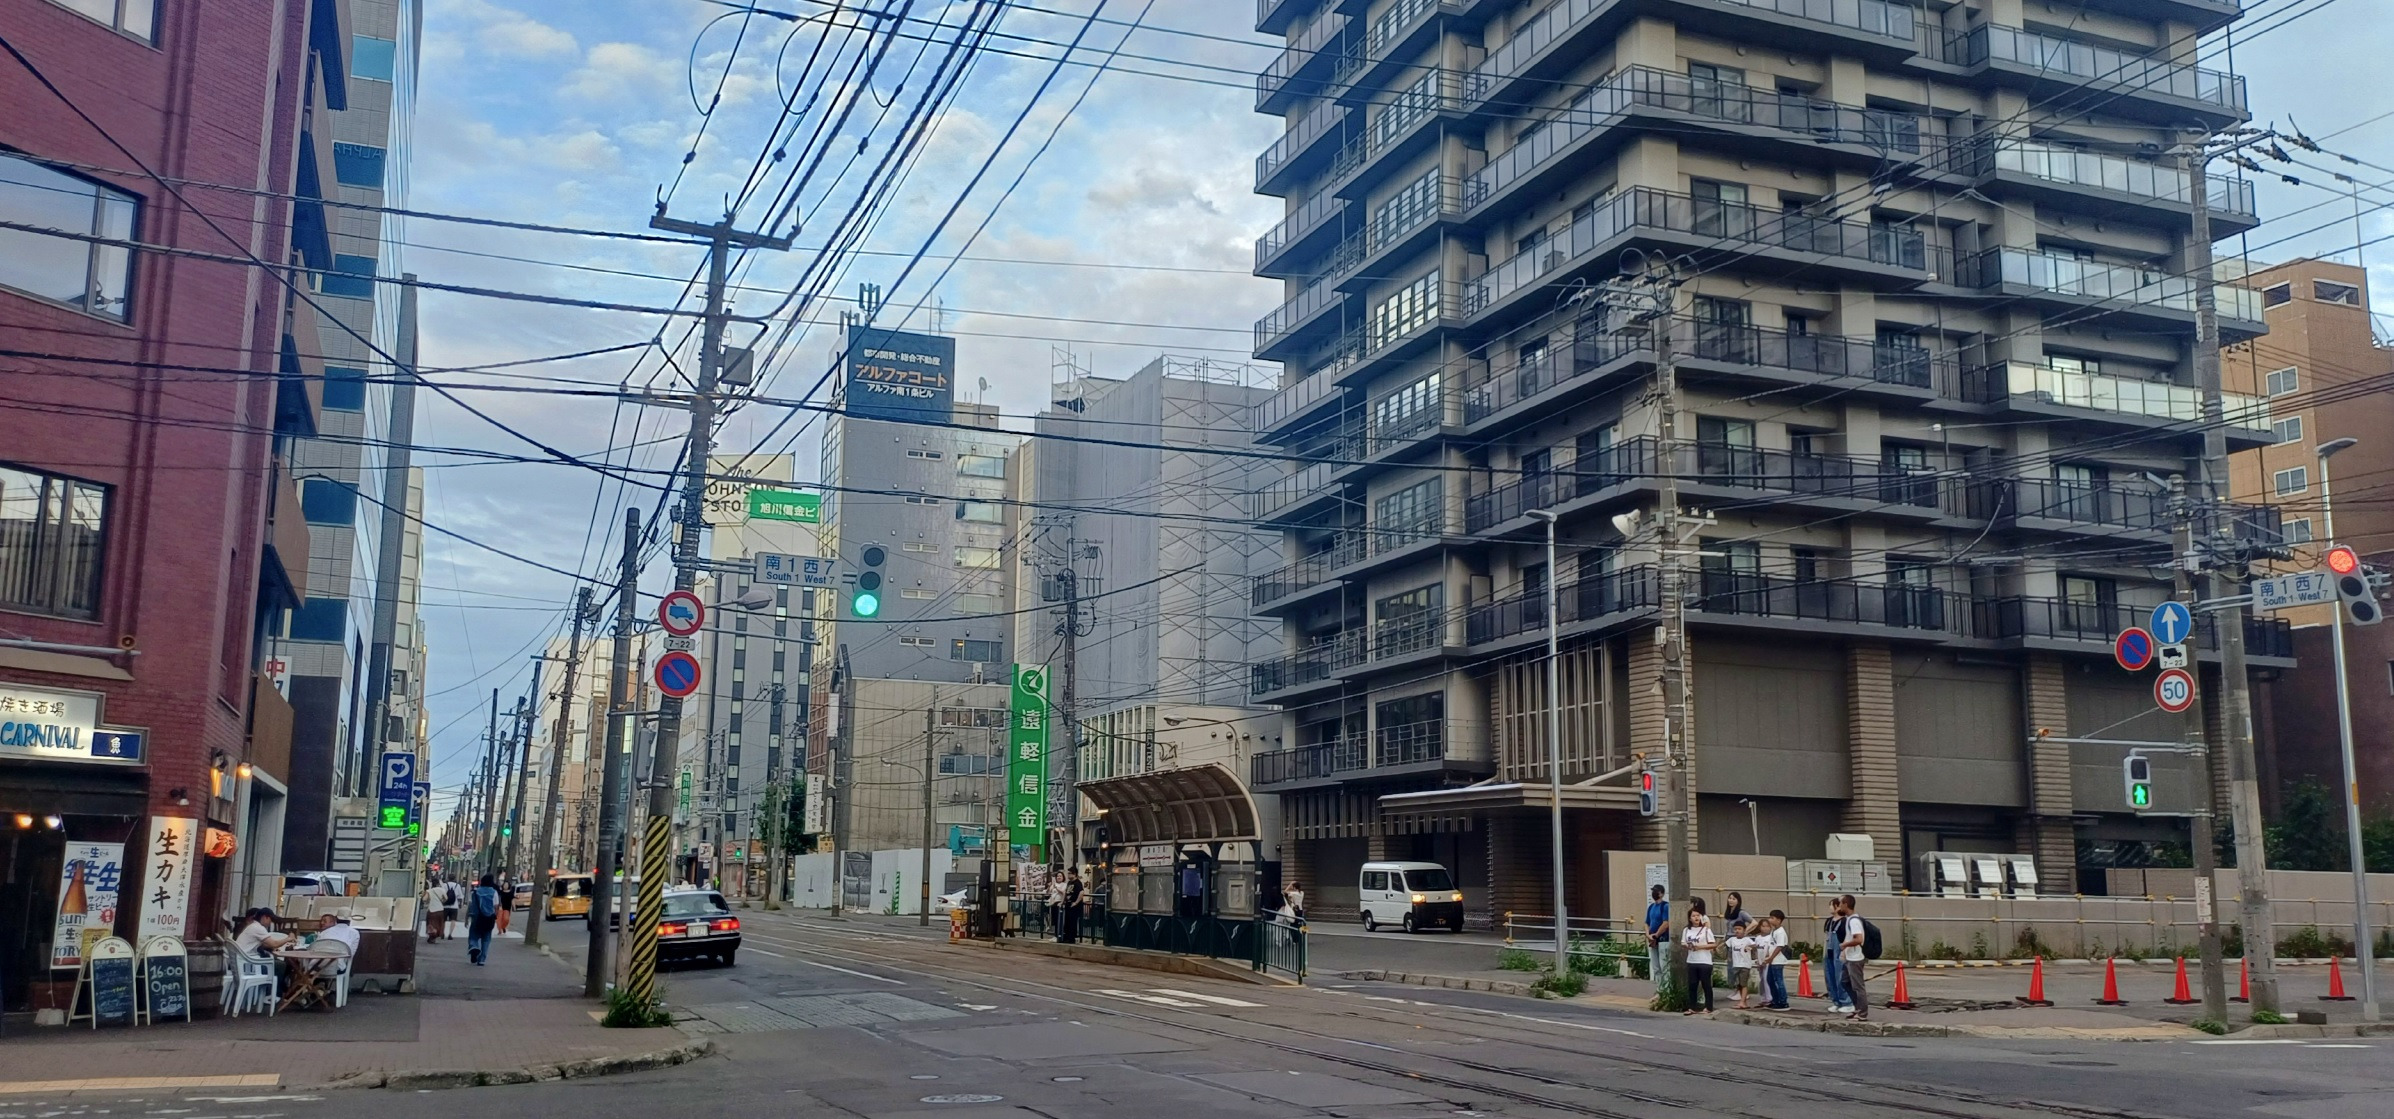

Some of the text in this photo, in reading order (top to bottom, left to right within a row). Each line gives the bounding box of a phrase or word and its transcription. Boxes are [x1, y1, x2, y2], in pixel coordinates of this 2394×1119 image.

[855, 364, 947, 387] アルファコート
[867, 383, 935, 398] アルファ南1条ビル
[766, 571, 791, 581] South
[804, 574, 826, 584] West
[829, 577, 835, 585] 7
[2263, 596, 2287, 606] South
[2298, 591, 2320, 601] West
[2322, 589, 2329, 598] 7
[669, 640, 691, 648] 7-22
[2163, 681, 2185, 700] 50
[0, 721, 84, 750] CARNIVAL
[1018, 709, 1041, 828] 遠軽信金
[393, 782, 408, 790] 24h
[151, 828, 180, 909] 生カキ
[150, 965, 183, 980] 16:00
[151, 981, 181, 995] Open
